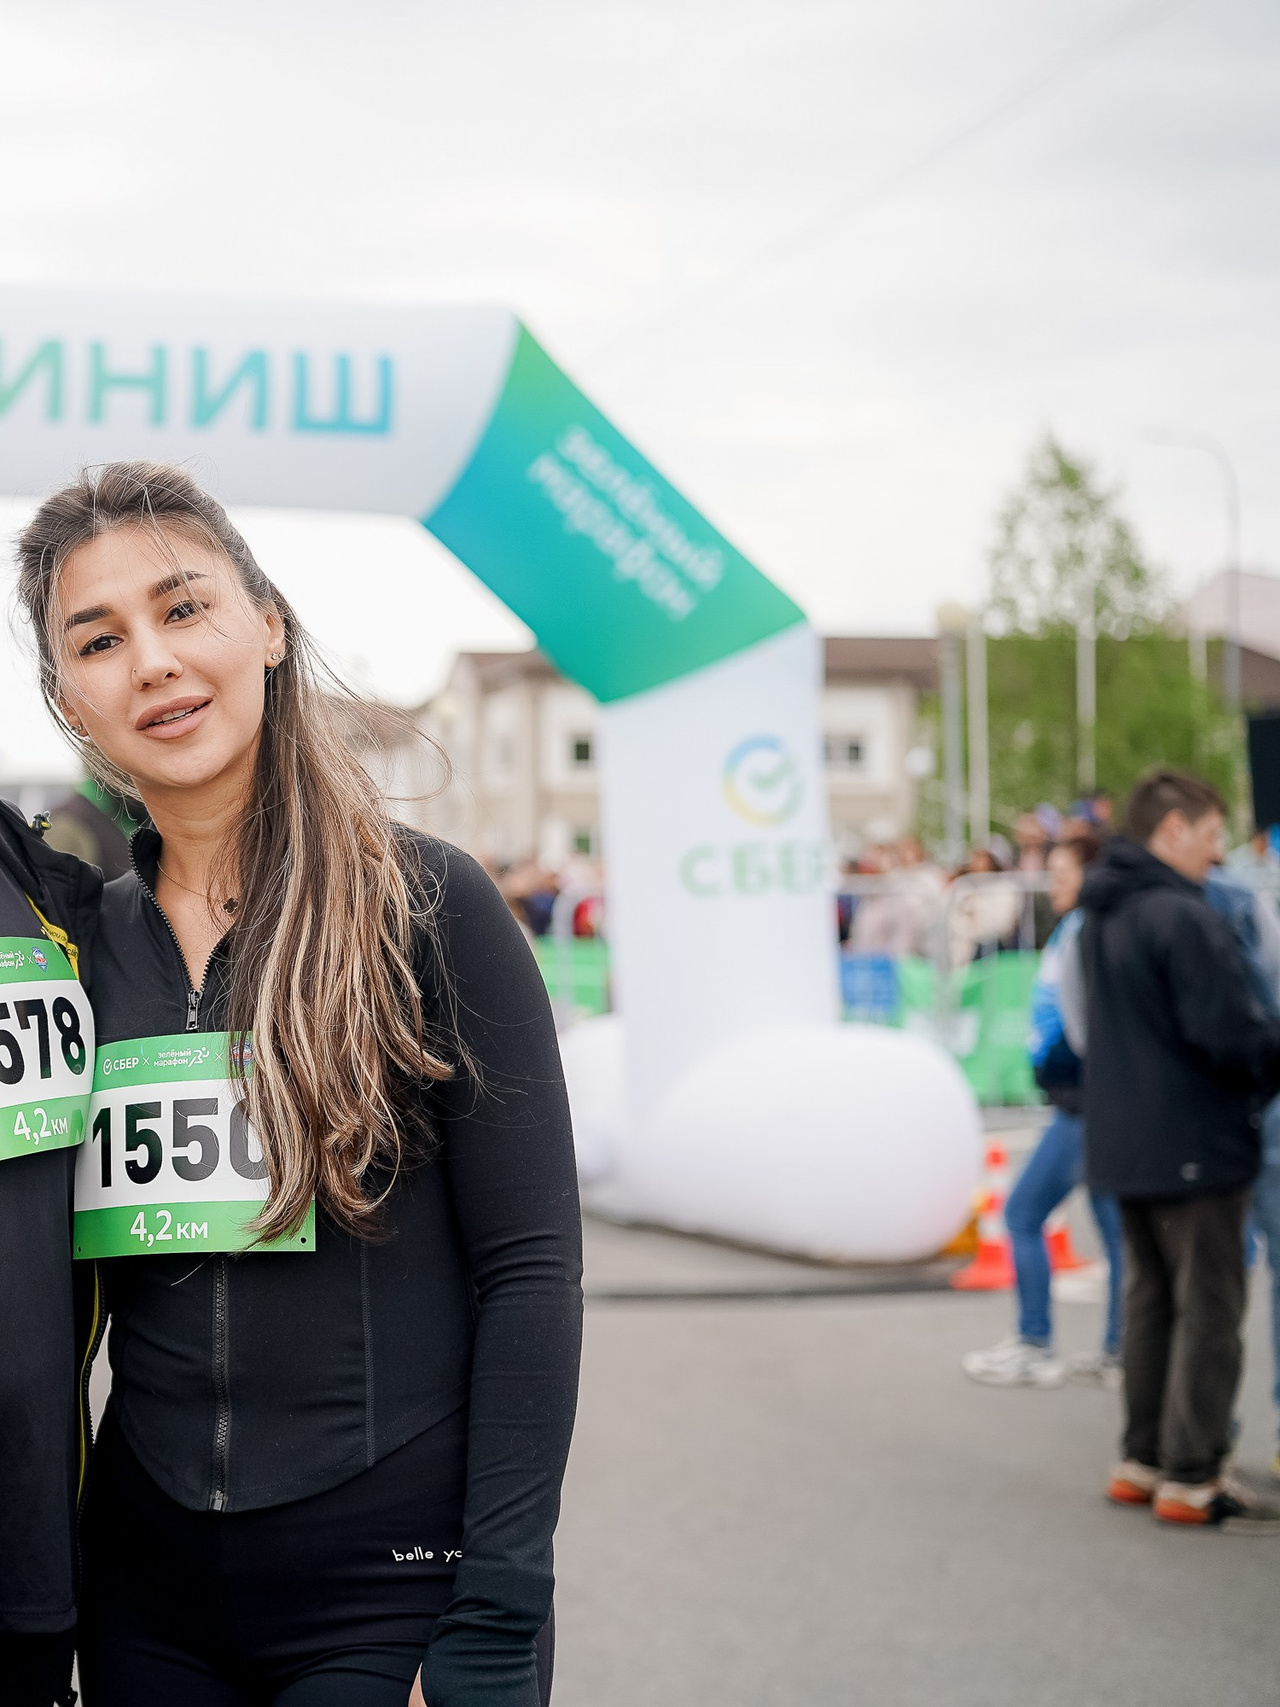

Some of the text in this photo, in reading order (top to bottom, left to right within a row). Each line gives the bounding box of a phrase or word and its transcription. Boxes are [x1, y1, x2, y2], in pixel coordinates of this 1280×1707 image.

[157, 1047, 192, 1058] зелёный
[113, 1057, 140, 1071] СБЕР
[153, 1058, 189, 1068] марафон
[392, 1546, 463, 1562] belle yo
